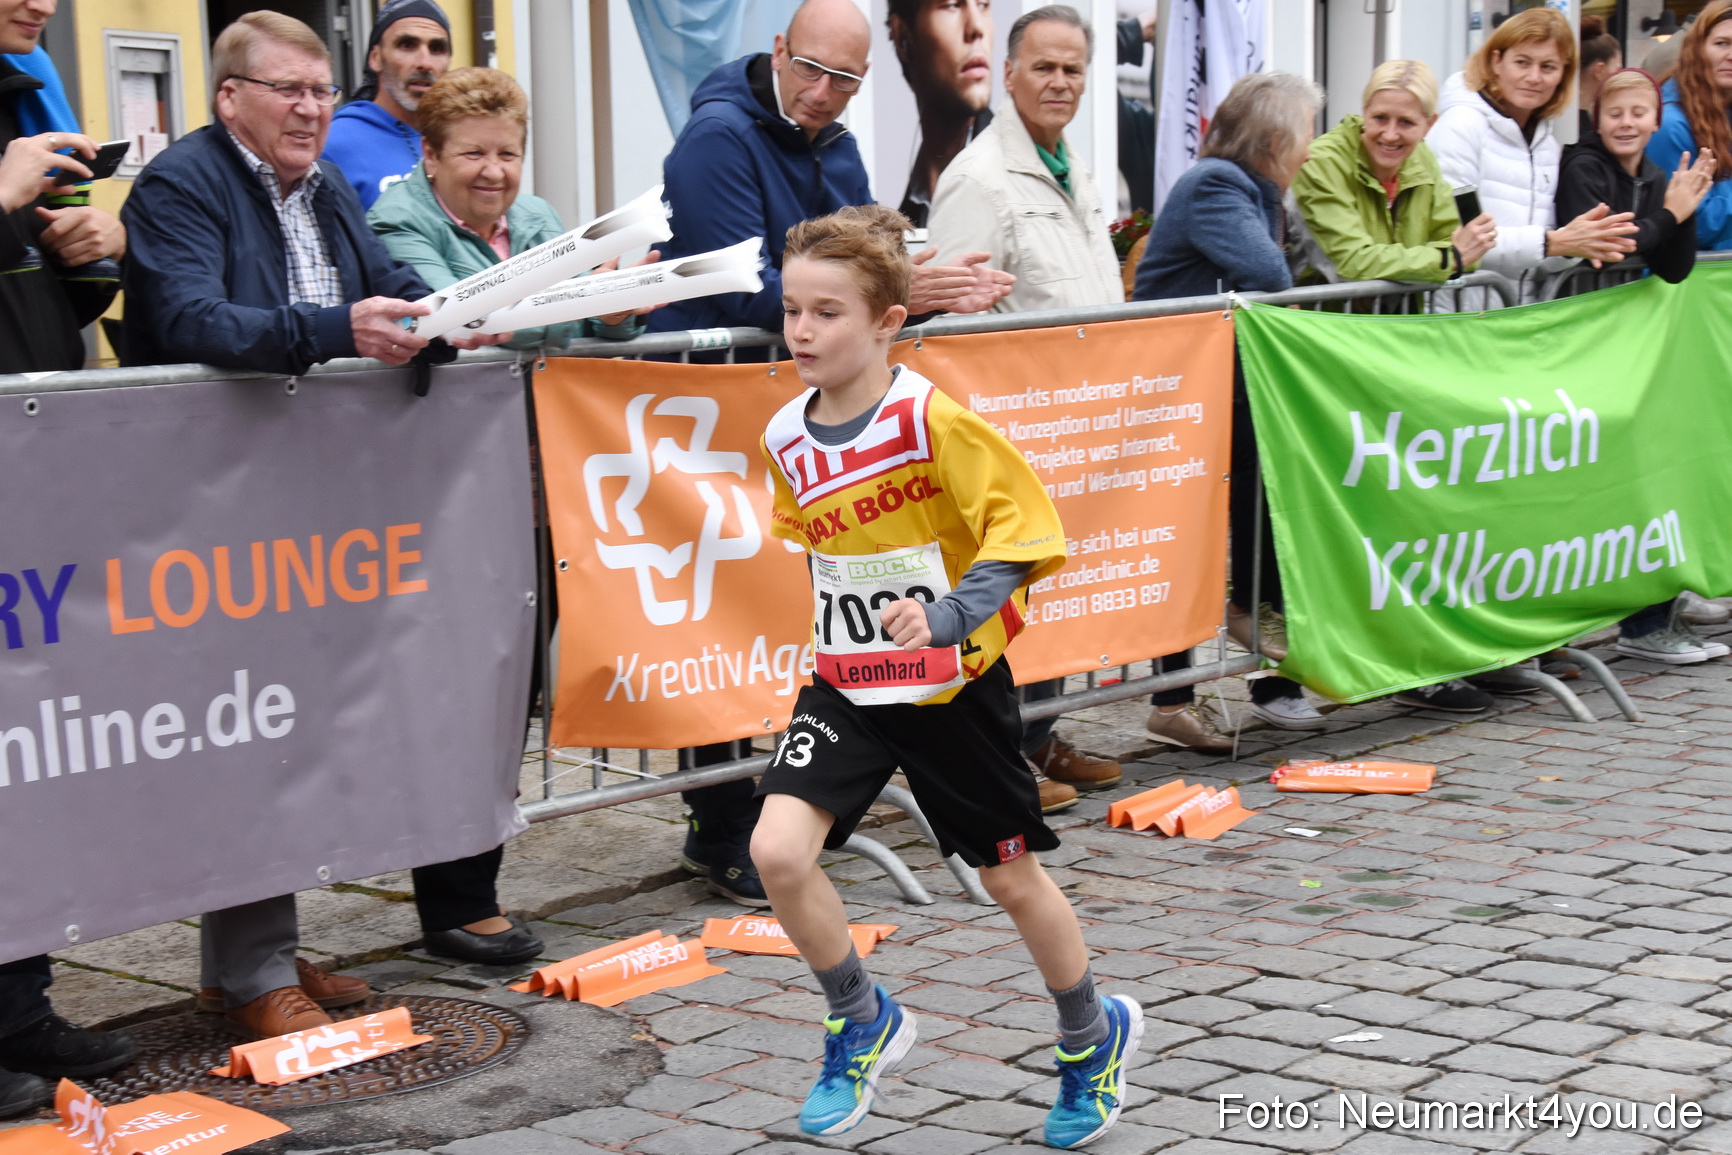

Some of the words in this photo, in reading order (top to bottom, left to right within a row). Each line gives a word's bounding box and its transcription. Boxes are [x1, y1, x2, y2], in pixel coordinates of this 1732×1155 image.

[551, 241, 577, 261] BMW
[968, 386, 1051, 413] Neumarkts
[1053, 380, 1130, 405] moderner
[1132, 374, 1183, 396] Partner
[1009, 415, 1090, 443] Konzeption
[1092, 407, 1121, 430] und
[1124, 402, 1204, 427] Umsetzung
[1342, 388, 1599, 491] Herzlich
[1024, 445, 1086, 474] Projekte
[1088, 444, 1119, 462] was
[1121, 432, 1181, 458] Internet,
[1058, 473, 1085, 498] und
[1088, 468, 1147, 492] Werbung
[1150, 456, 1208, 487] angeht.
[852, 475, 944, 526] BÖGL
[1081, 530, 1111, 554] sich
[1114, 527, 1139, 549] bei
[1142, 526, 1176, 545] uns:
[106, 522, 429, 636] LOUNGE
[847, 551, 930, 579] BOCK
[902, 570, 932, 582] concepts
[1059, 553, 1160, 589] codeclinic.de
[820, 585, 936, 646] 702
[1042, 595, 1088, 623] 09181
[1091, 588, 1137, 614] 8833
[1140, 581, 1171, 605] 897
[836, 657, 926, 683] Leonhard
[631, 942, 688, 976] DESIGN
